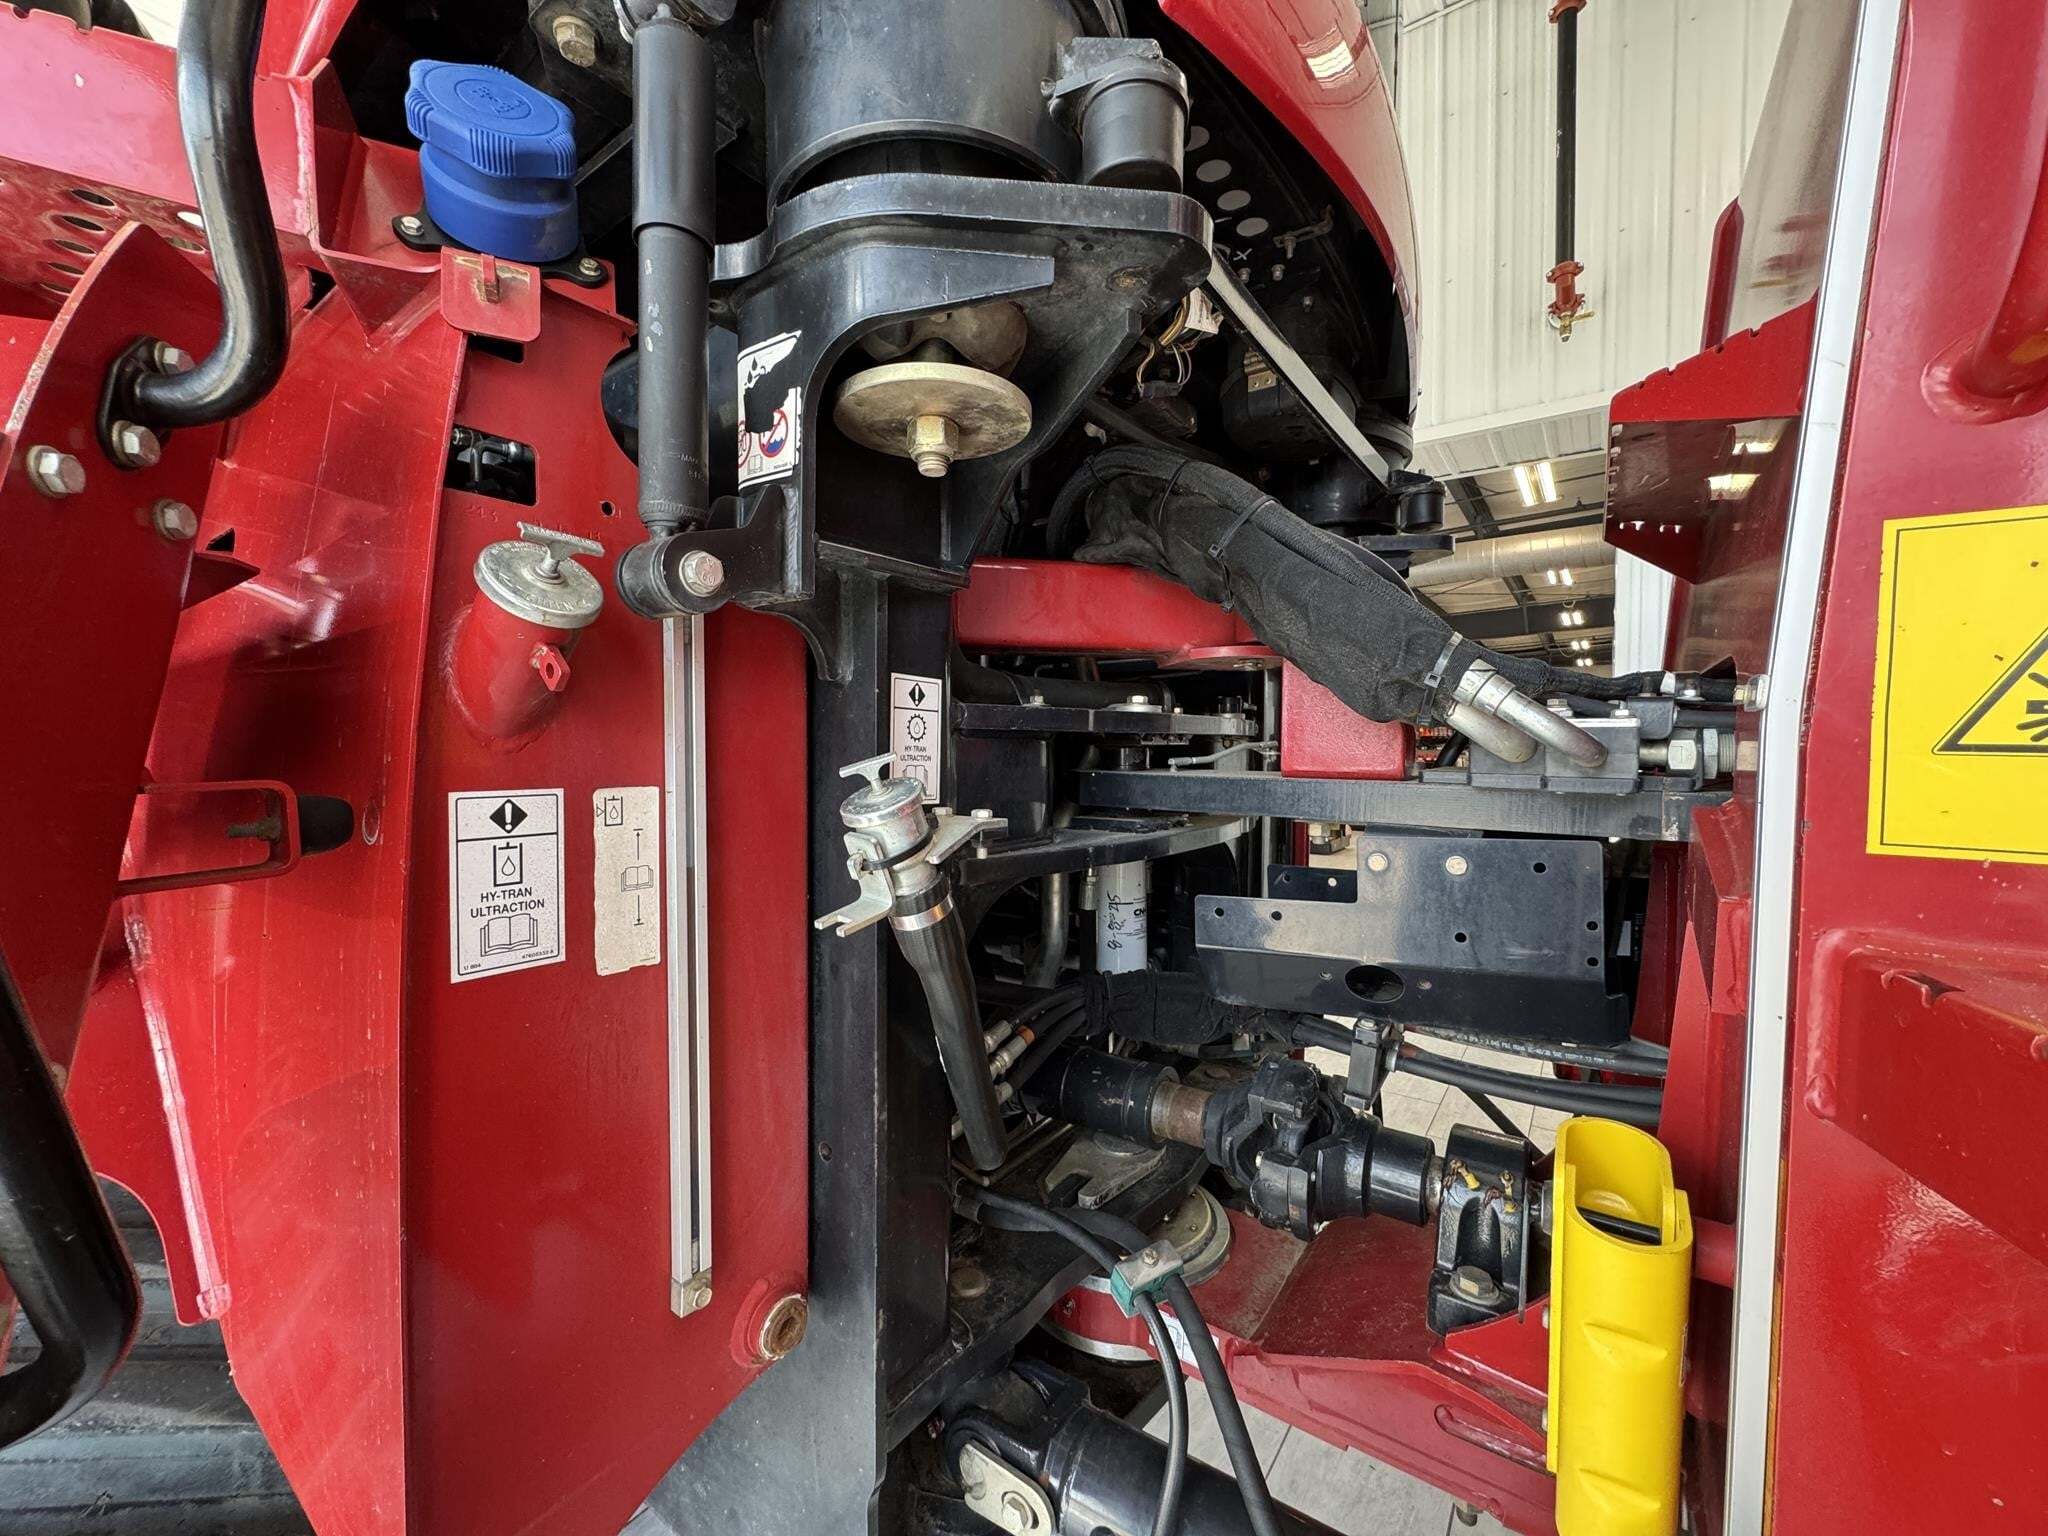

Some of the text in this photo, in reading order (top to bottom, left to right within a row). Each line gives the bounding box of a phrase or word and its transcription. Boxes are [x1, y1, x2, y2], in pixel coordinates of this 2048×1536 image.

[900, 754, 932, 762] ULTRACTION
[480, 886, 533, 903] HY-TRAN
[470, 898, 546, 919] ULTRACTION
